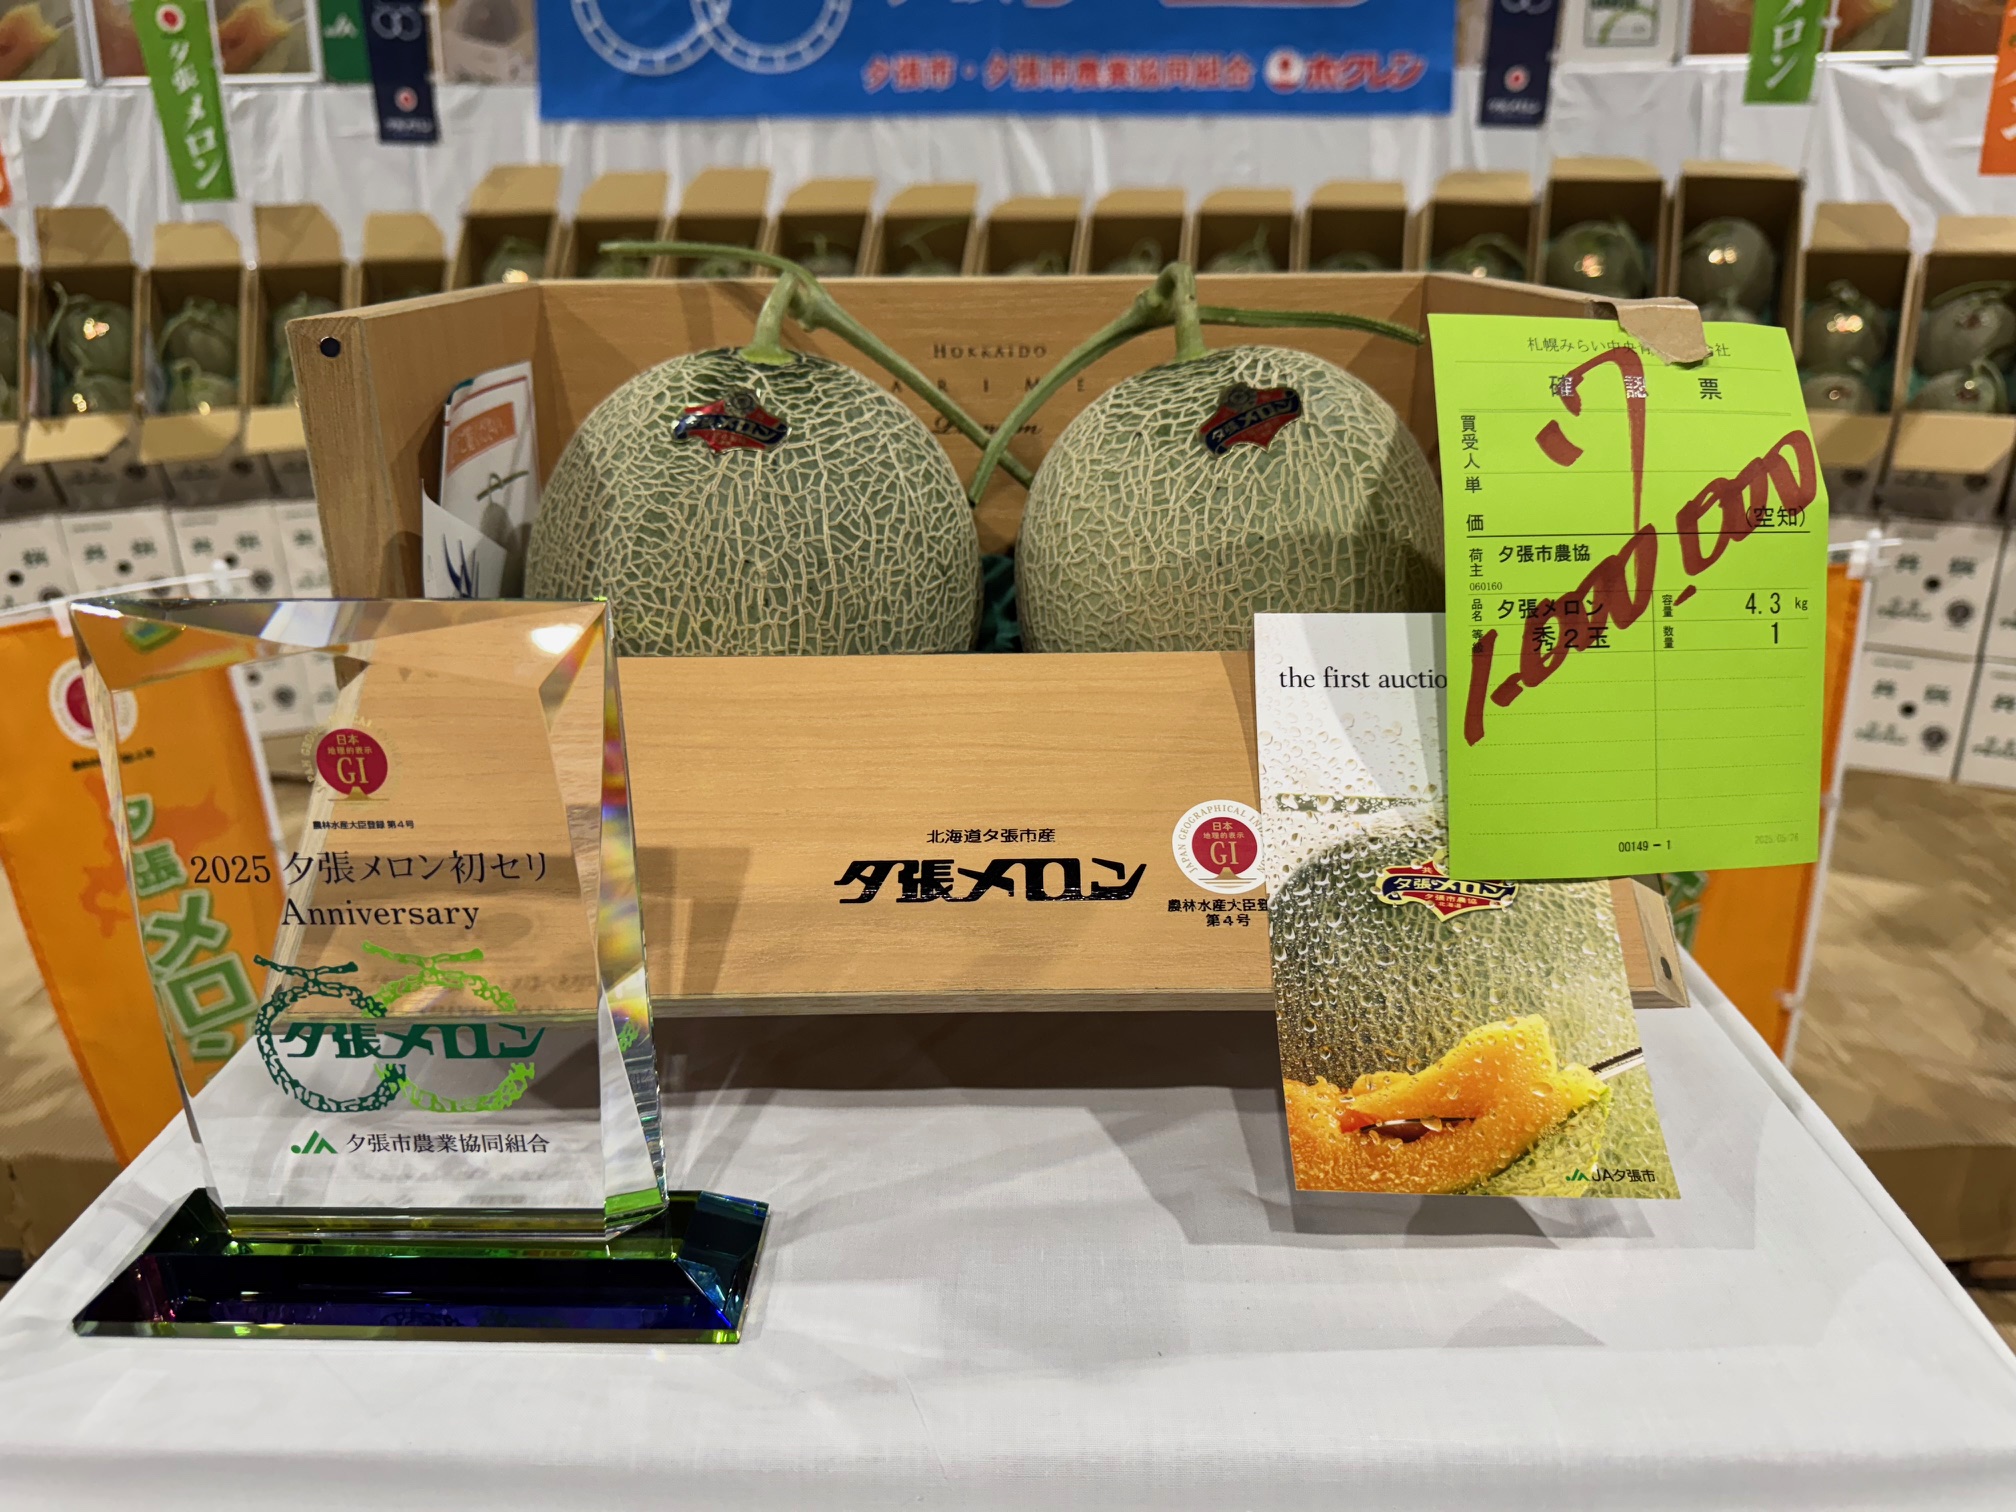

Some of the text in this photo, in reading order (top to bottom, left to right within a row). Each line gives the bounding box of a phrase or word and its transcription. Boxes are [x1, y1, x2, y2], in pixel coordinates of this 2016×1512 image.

[932, 344, 1048, 359] HOKKAIDO
[1460, 414, 1480, 469] 買受人
[1498, 544, 1591, 563] 夕張市農協
[1469, 582, 1503, 591] 060160
[1471, 598, 1483, 622] 品名
[1497, 598, 1604, 620] 夕張メロン
[1662, 594, 1674, 618] 容量
[1745, 592, 1808, 615] 4.3 kg
[1663, 625, 1674, 649] 数量
[1771, 621, 1778, 644] 1
[1279, 666, 1448, 688] the first auctio
[336, 734, 360, 745] 日本
[336, 757, 370, 785] GI
[1178, 804, 1248, 840] GEOGRAPHICAL
[1212, 821, 1233, 832] 日本
[926, 828, 1056, 844] 北海道夕張市産
[1203, 831, 1245, 840] 地理的表示
[1618, 840, 1649, 852] 00149
[1178, 844, 1199, 874] JAPAN
[1210, 841, 1239, 866] GI
[190, 849, 547, 886] 2025 夕張メロン初セリ
[834, 857, 1147, 904] 夕張メロン
[1393, 876, 1506, 898] 夕張メロン
[281, 899, 480, 930] Anniversary
[1167, 898, 1269, 912] 農林水産大臣登
[279, 1022, 546, 1059] 夕張メロン
[347, 1133, 551, 1153] 夕張市農業協同組合
